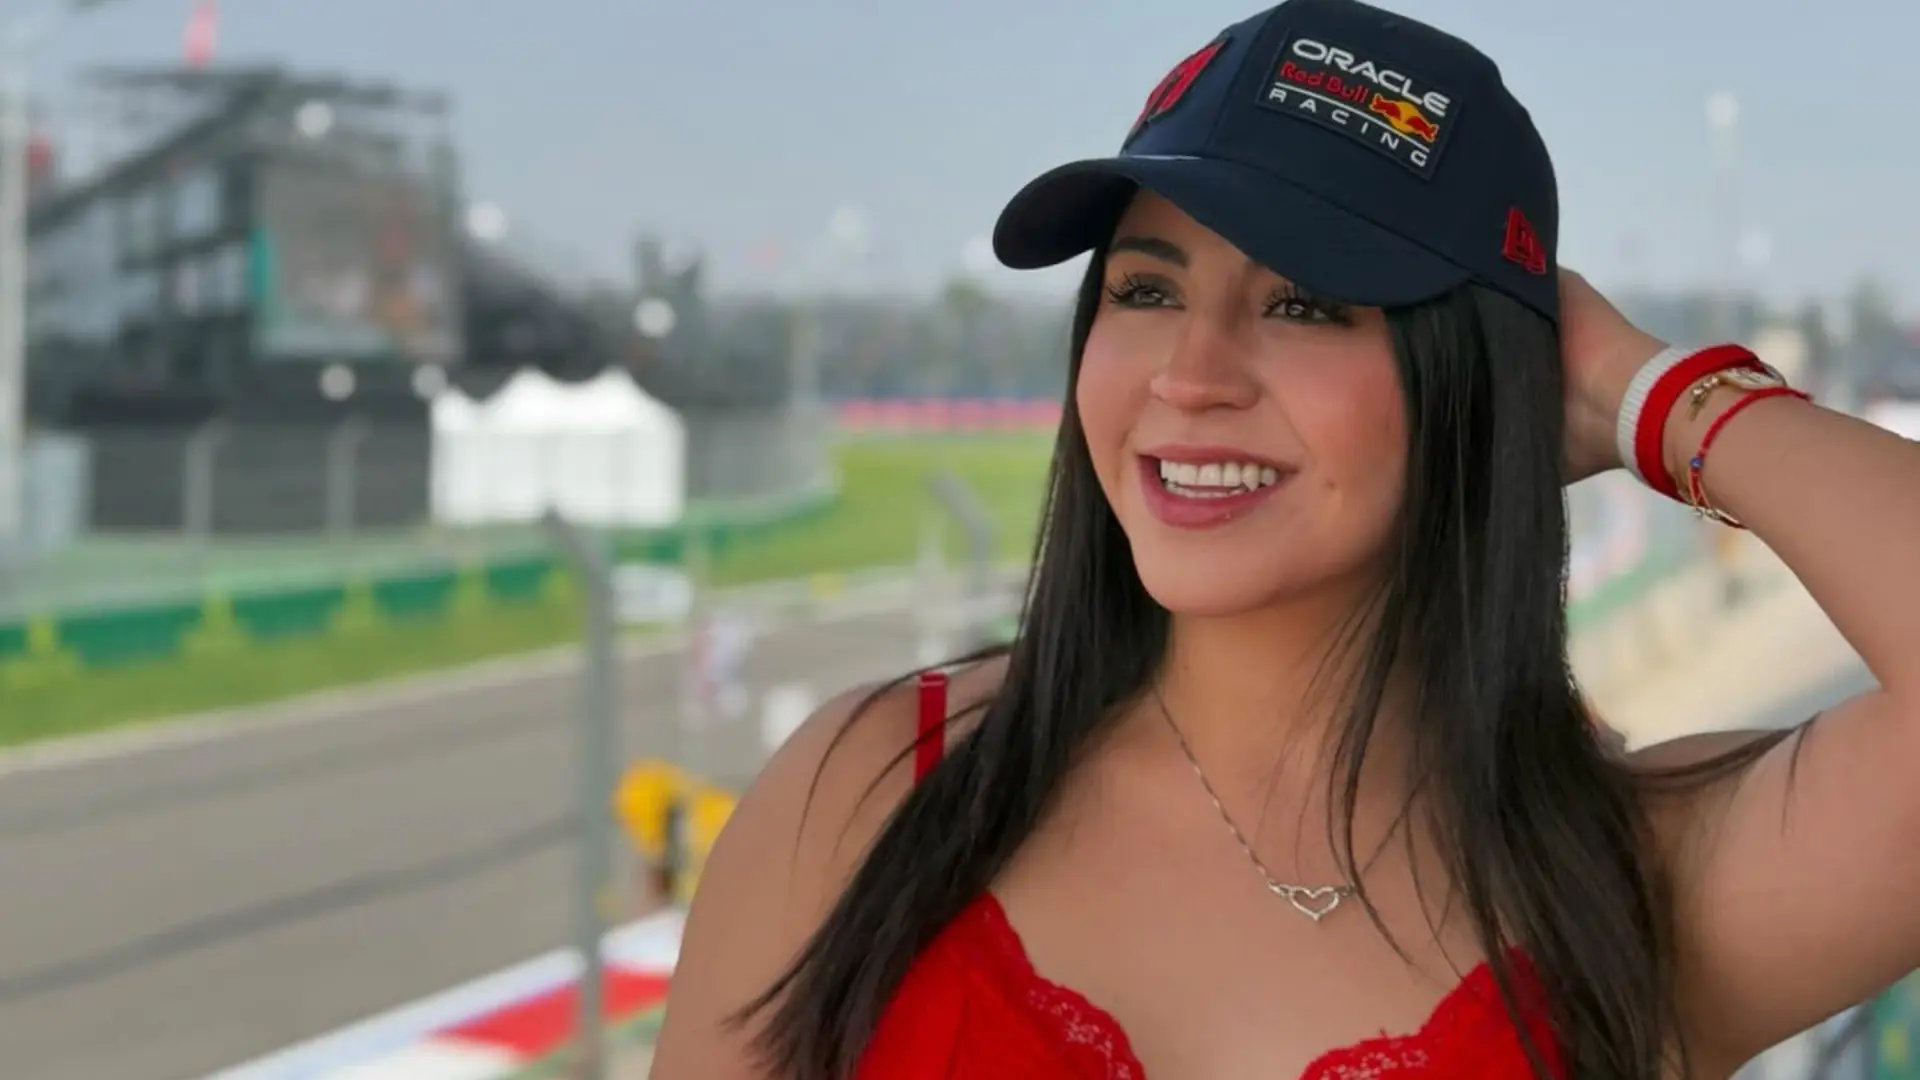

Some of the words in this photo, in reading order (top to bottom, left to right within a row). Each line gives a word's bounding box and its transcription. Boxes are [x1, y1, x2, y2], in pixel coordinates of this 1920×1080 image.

[1280, 61, 1324, 86] Red
[1326, 76, 1369, 104] Bull
[1292, 39, 1451, 117] ORACLE
[1269, 88, 1427, 167] RACING
